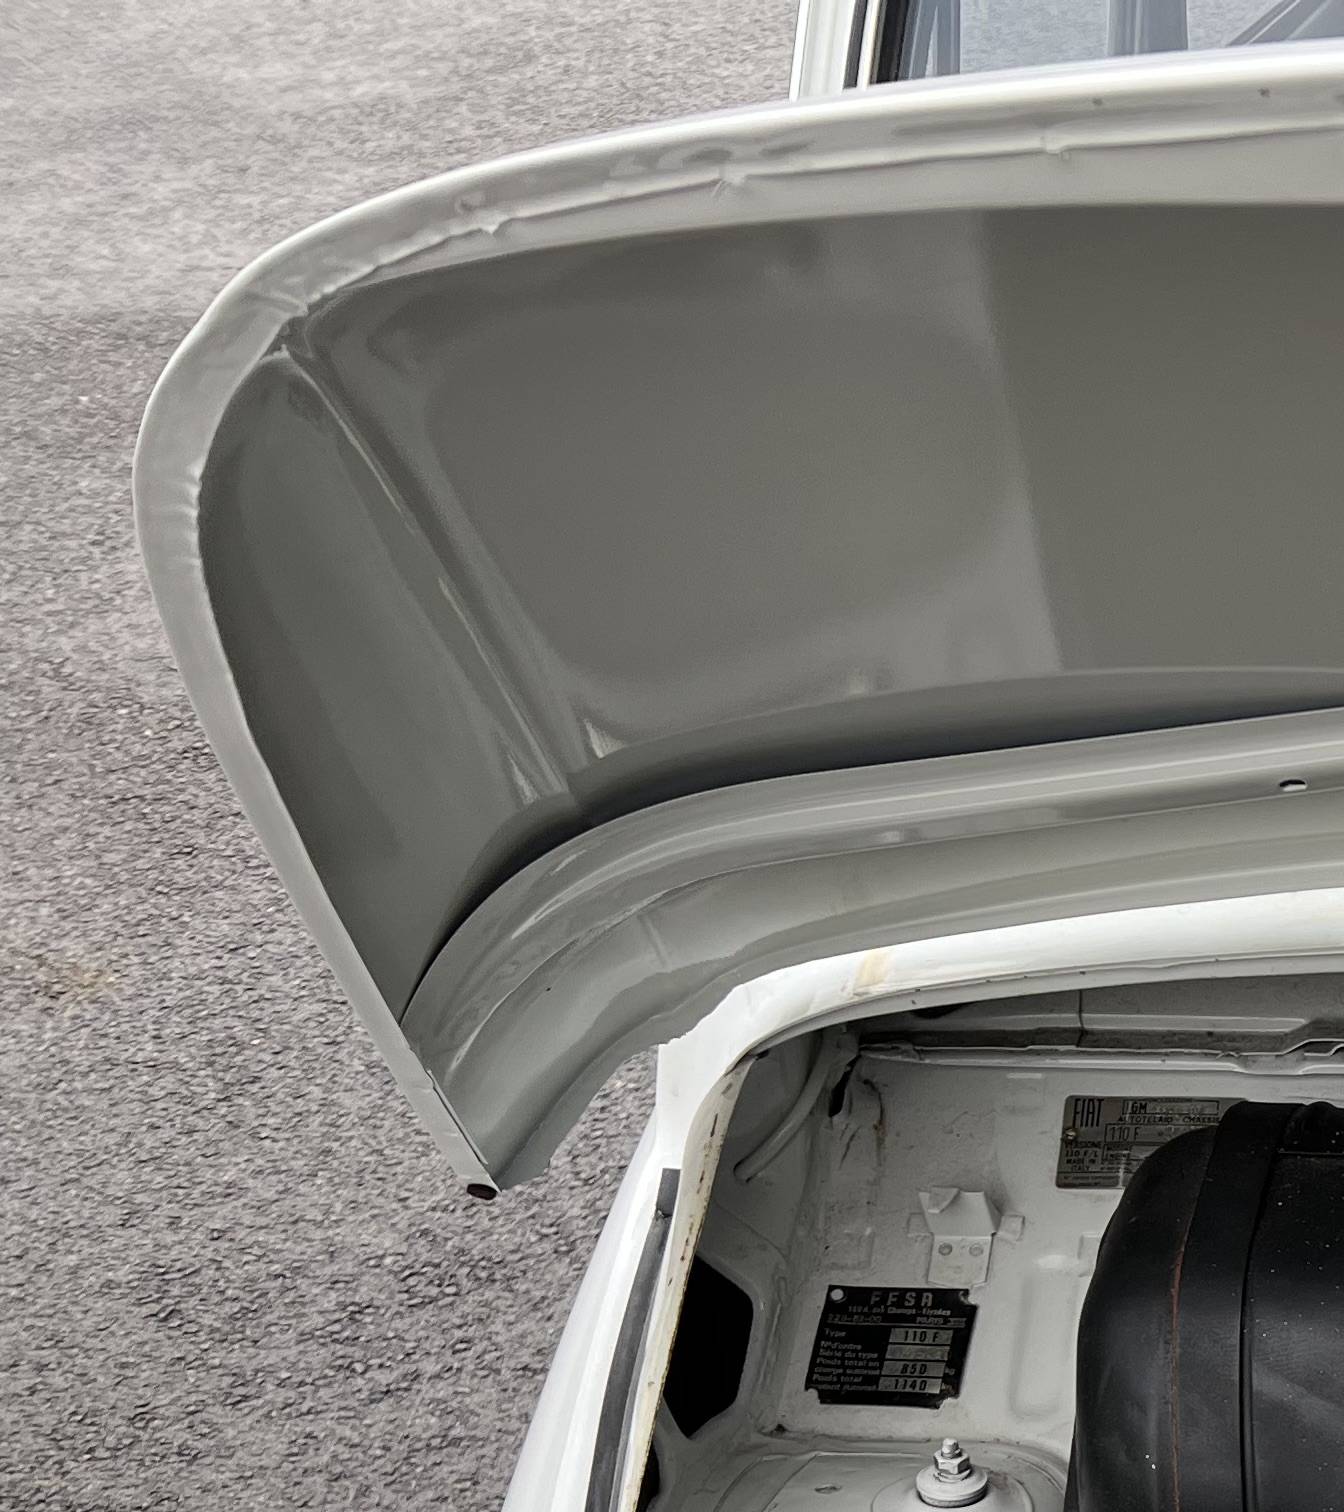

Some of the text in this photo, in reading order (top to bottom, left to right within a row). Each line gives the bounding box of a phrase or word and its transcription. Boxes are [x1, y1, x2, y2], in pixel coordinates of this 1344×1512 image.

[1072, 1098, 1104, 1128] FIAT
[1109, 1127, 1141, 1142] 110 F
[871, 1291, 933, 1307] FFSA
[825, 1328, 847, 1338] Type
[904, 1330, 940, 1343] 110 F
[858, 1351, 878, 1359] type
[901, 1363, 927, 1375] 850
[894, 1379, 927, 1391] 1140
